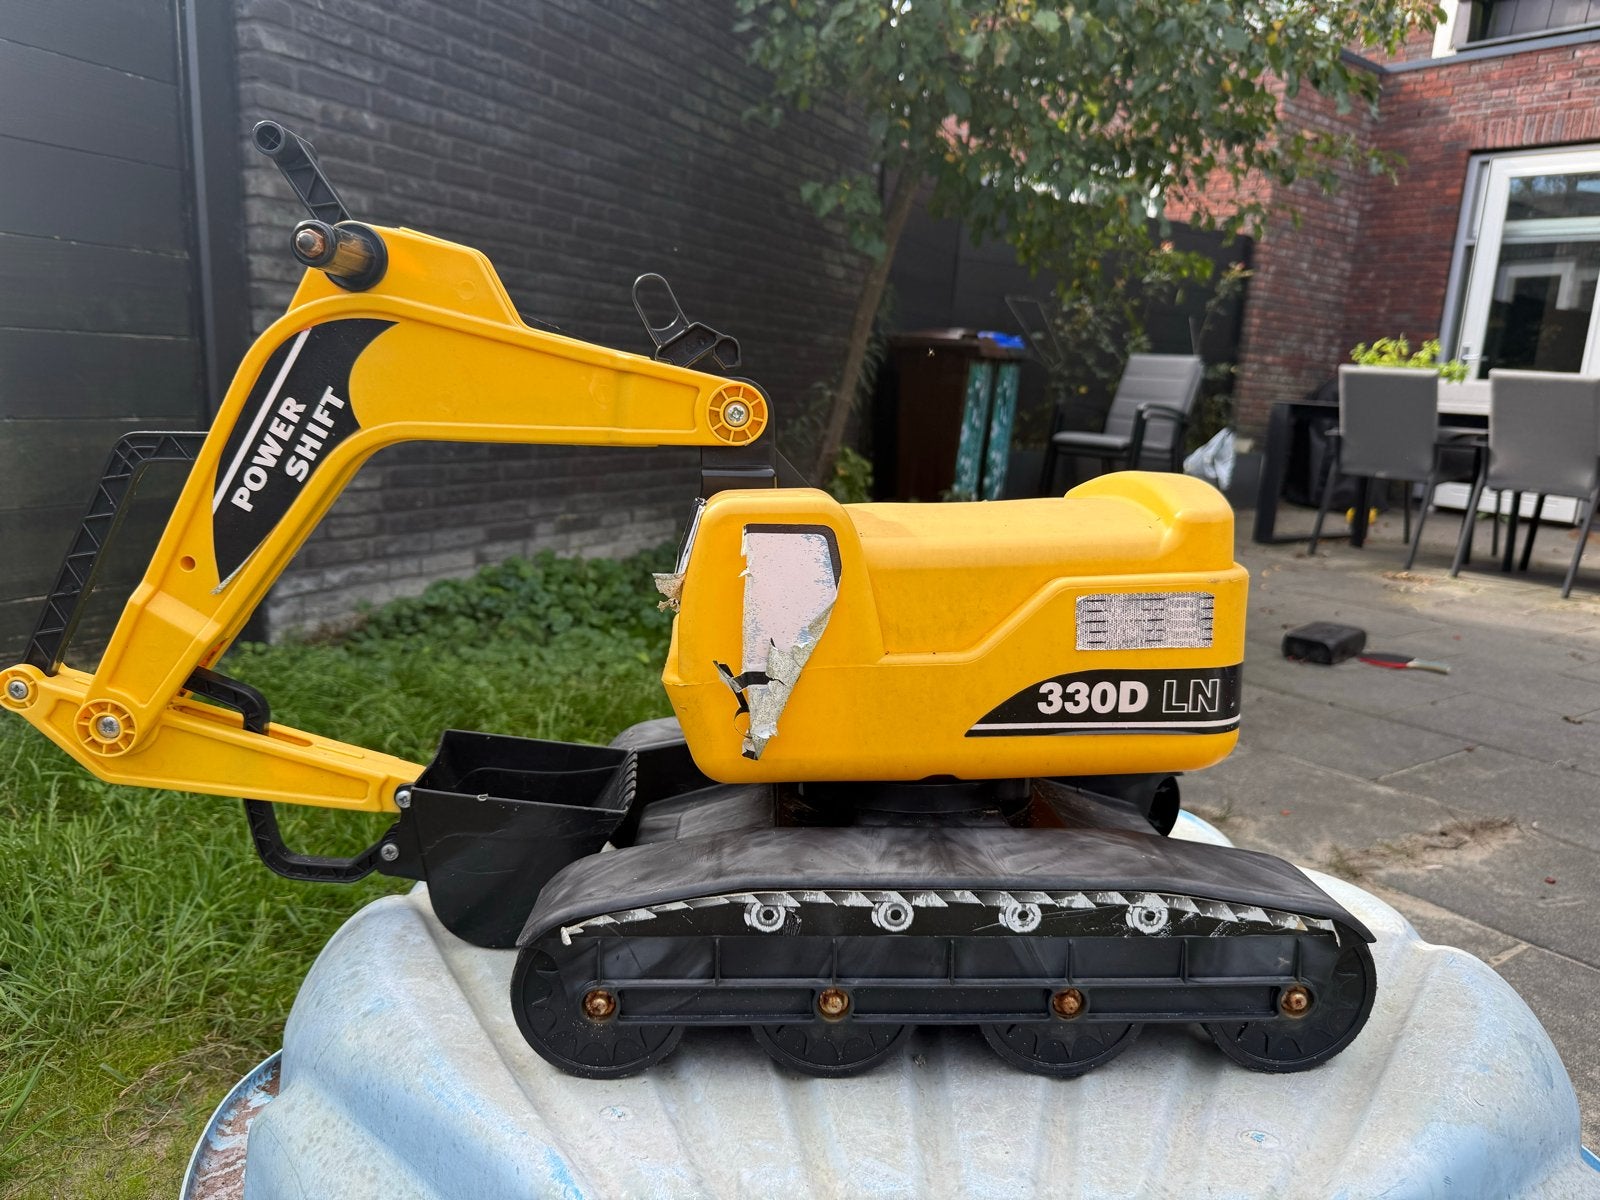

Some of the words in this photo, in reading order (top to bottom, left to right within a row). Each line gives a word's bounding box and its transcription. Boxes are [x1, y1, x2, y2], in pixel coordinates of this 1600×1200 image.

[231, 396, 307, 512] POWER
[285, 385, 345, 482] SHIFT
[1037, 681, 1149, 714] 330D
[1162, 679, 1220, 713] LN
